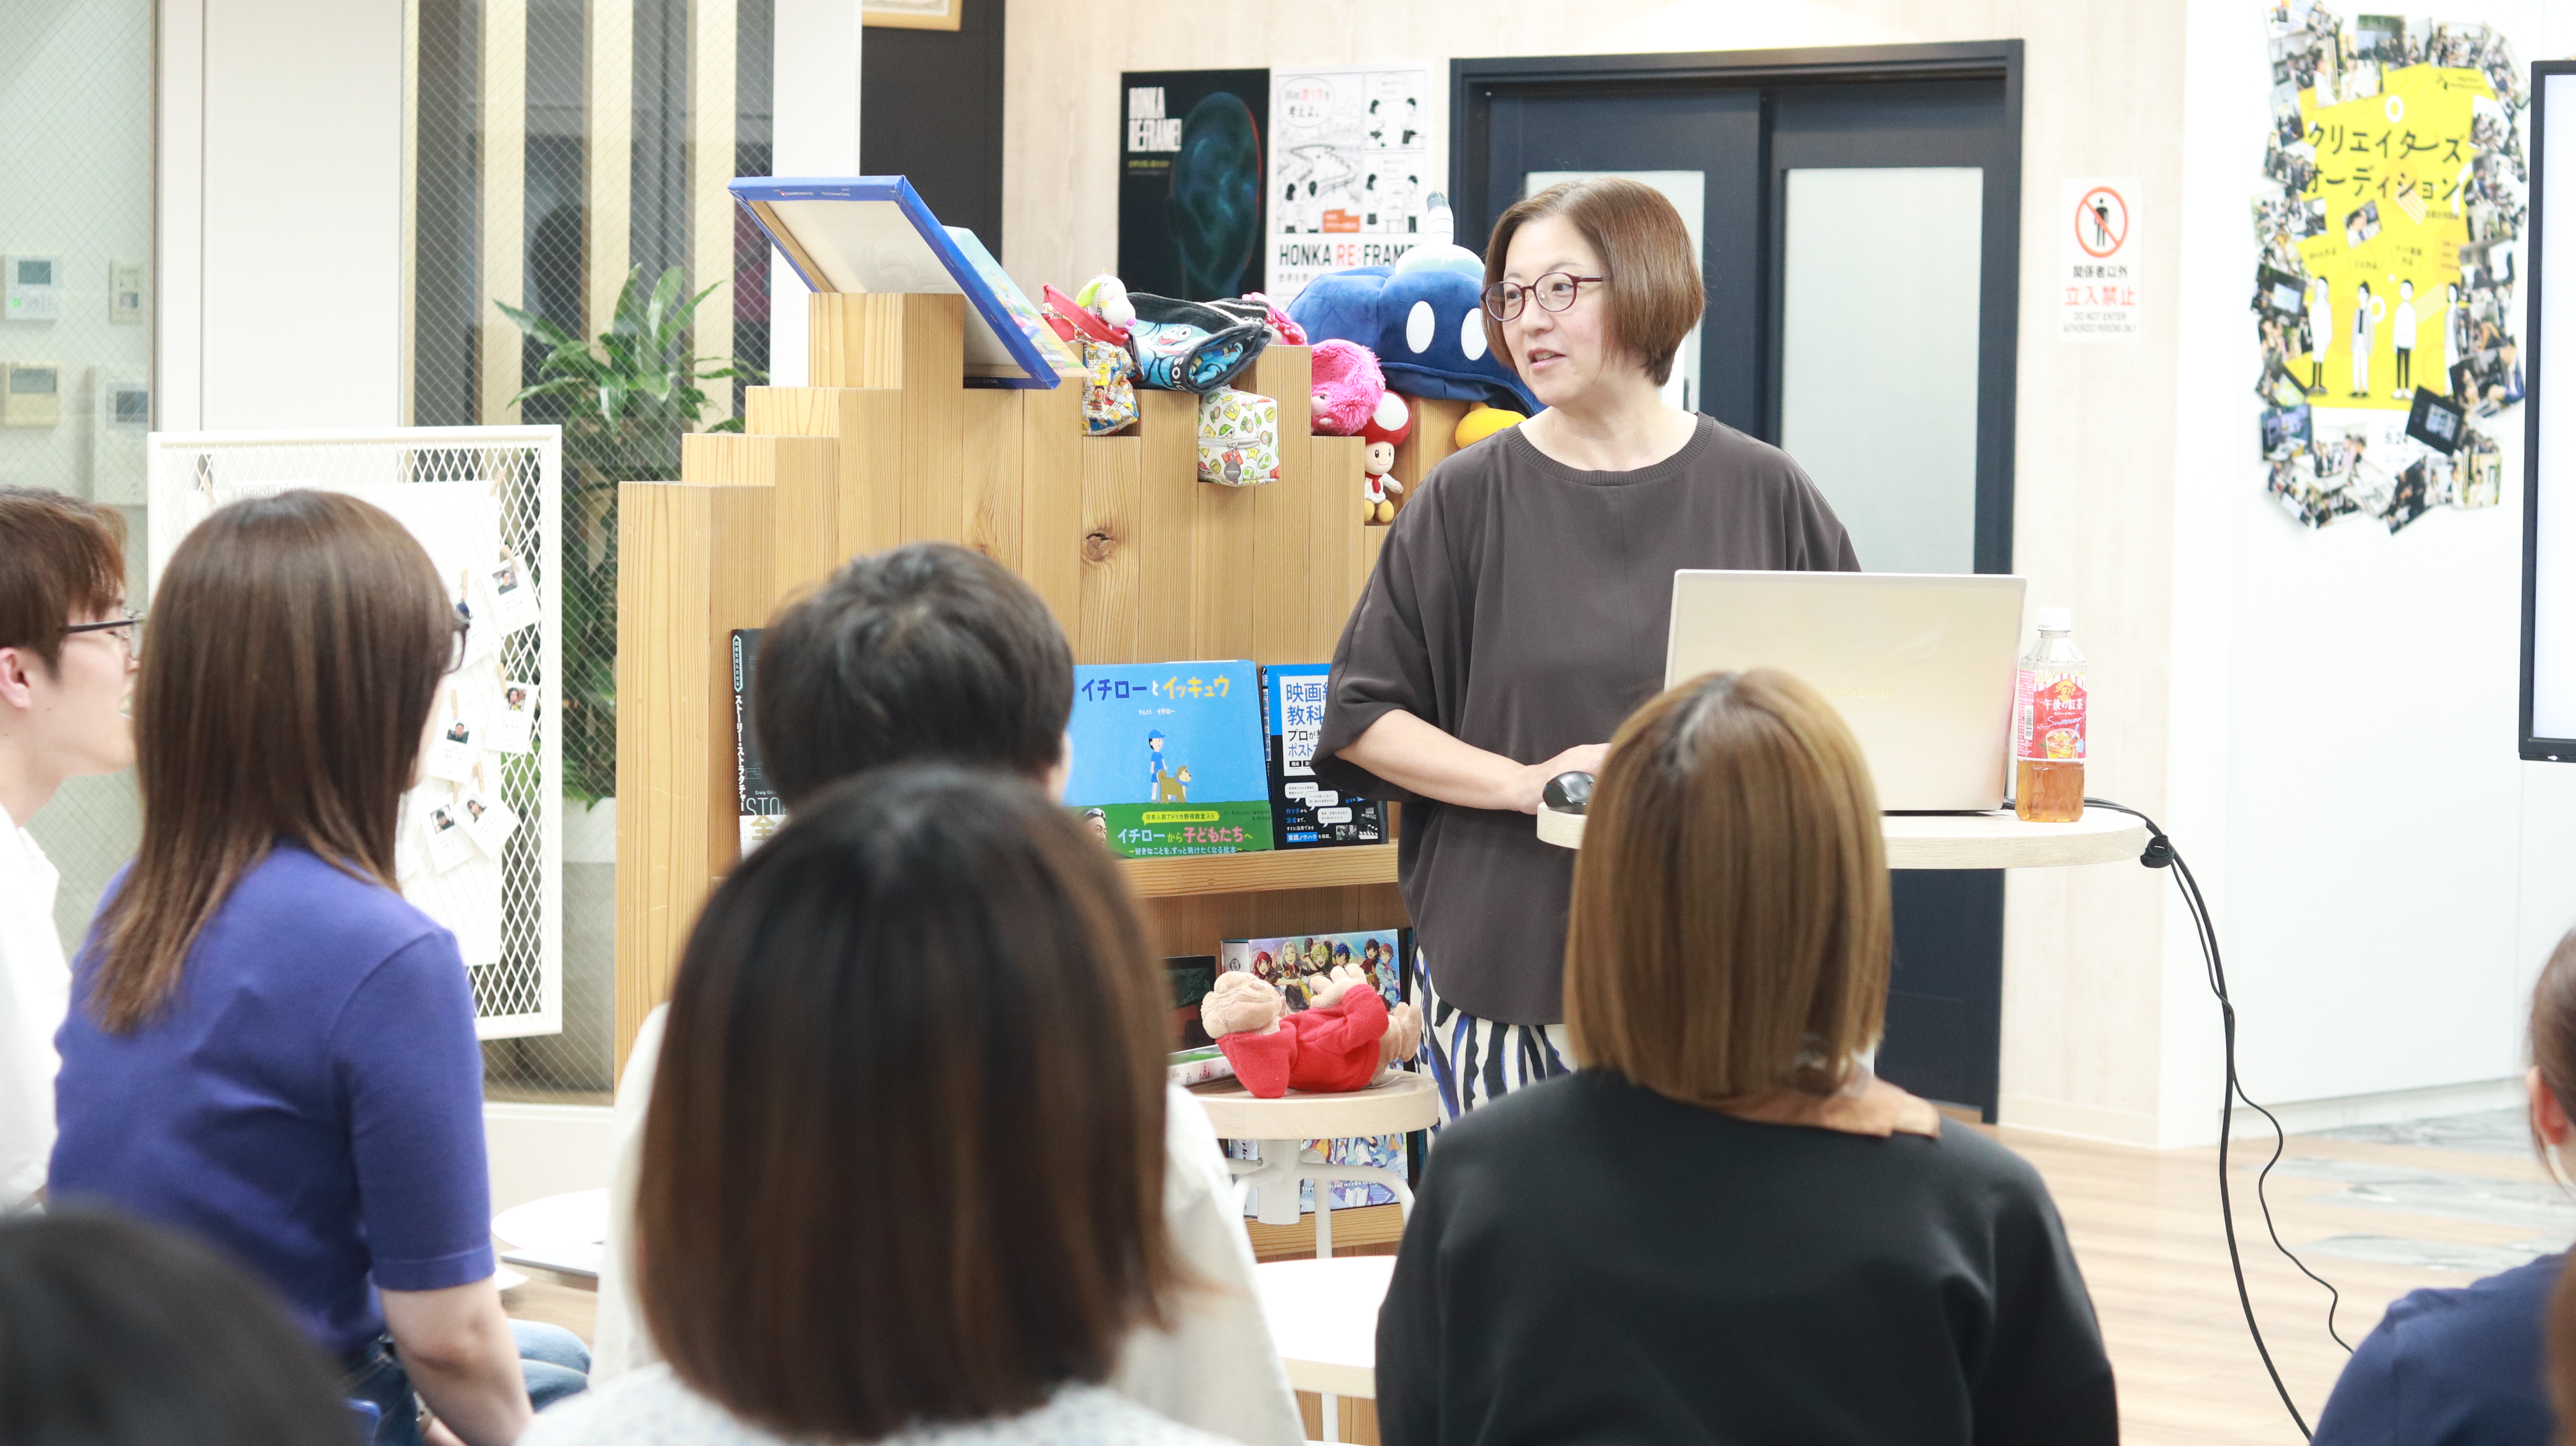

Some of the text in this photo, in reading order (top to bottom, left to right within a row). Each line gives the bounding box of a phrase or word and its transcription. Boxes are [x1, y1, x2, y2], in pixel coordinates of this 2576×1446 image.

[2309, 122, 2465, 163] クリエイターズ
[2310, 163, 2460, 200] オーディション
[1279, 244, 1420, 266] HONKA RE:FRAM
[2073, 265, 2128, 278] 関係者以外
[2065, 285, 2136, 306] 立入禁止
[2074, 312, 2127, 321] DO NOT ENTER
[1081, 675, 1229, 702] イチローとイッキュウ
[2043, 698, 2084, 711] 午後の紅茶
[1287, 705, 1325, 726] 教科
[735, 695, 746, 811] ストーリー・ストラクチャー
[1288, 743, 1318, 757] ポスト
[746, 797, 788, 815] STO
[1146, 812, 1215, 820] 日本人初アメリカ野球殿堂入り
[1117, 826, 1253, 844] イチローから子どもたちへ
